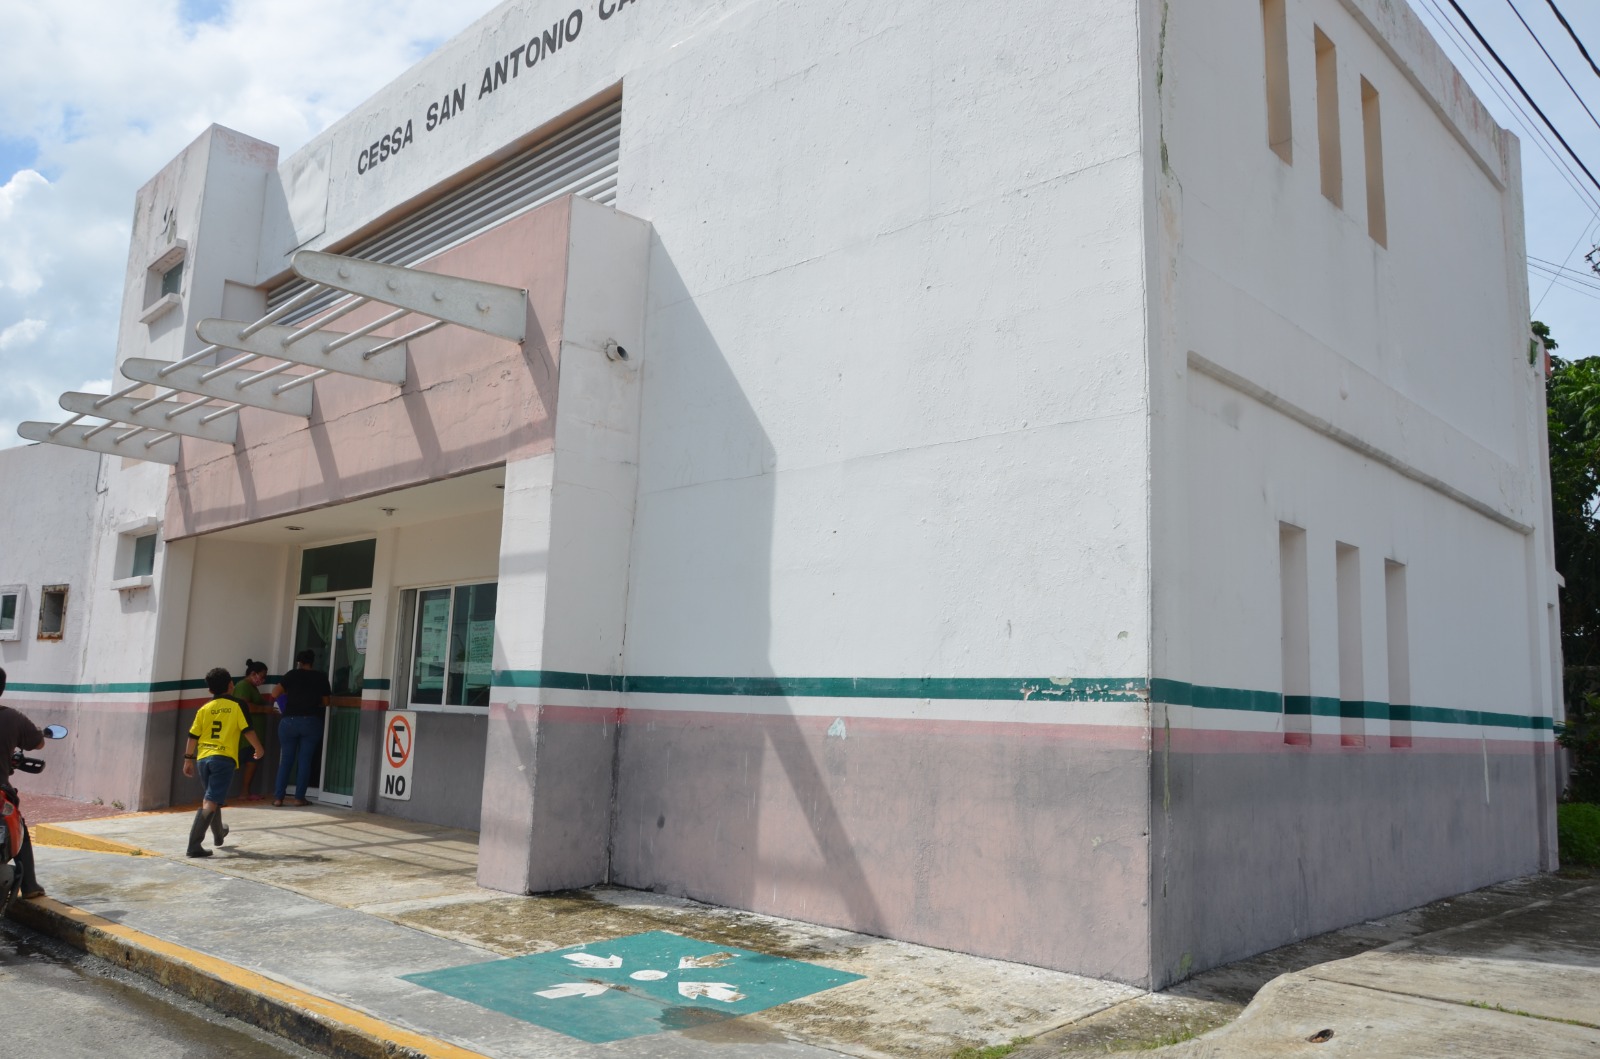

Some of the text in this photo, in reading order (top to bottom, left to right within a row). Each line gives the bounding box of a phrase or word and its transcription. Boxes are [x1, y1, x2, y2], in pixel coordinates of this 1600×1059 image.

[357, 119, 414, 175] CESSA
[426, 83, 466, 132] SAN
[478, 9, 583, 100] ANTONIO
[210, 720, 223, 739] 2
[384, 774, 406, 796] NO
